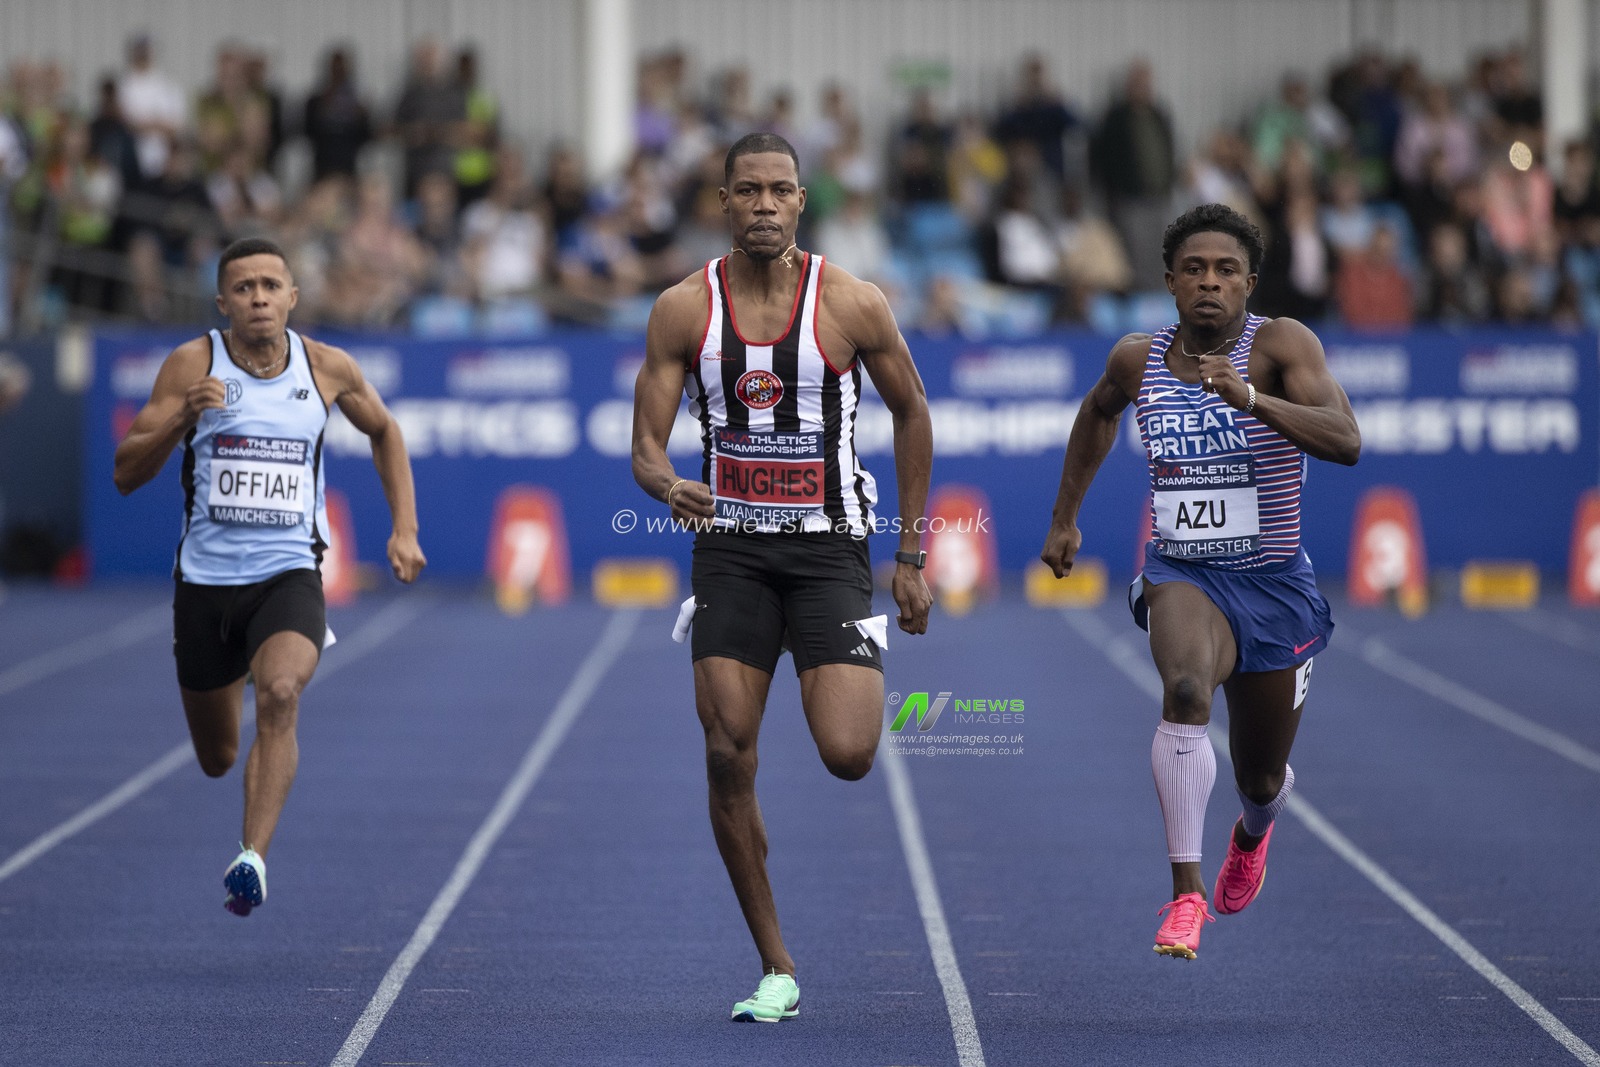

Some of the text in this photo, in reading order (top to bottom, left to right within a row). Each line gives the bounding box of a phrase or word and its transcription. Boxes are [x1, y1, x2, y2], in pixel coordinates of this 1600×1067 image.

[1147, 407, 1238, 437] GREAT
[237, 437, 305, 451] ATHLETICS
[720, 431, 818, 445] UK ATHLETICS
[1150, 429, 1248, 460] BRITAIN
[217, 447, 305, 462] CHAMPIONSHIPS
[720, 441, 818, 454] CHAMPIONSHIPS
[1157, 464, 1249, 477] UK ATHLETICS
[219, 469, 299, 501] OFFIAH
[722, 463, 819, 497] HUGHES
[1157, 474, 1250, 486] CHAMPIONSHIPS
[214, 507, 299, 526] MANCHESTER
[1175, 499, 1227, 530] AZU
[1166, 538, 1252, 556] MANCHESTER
